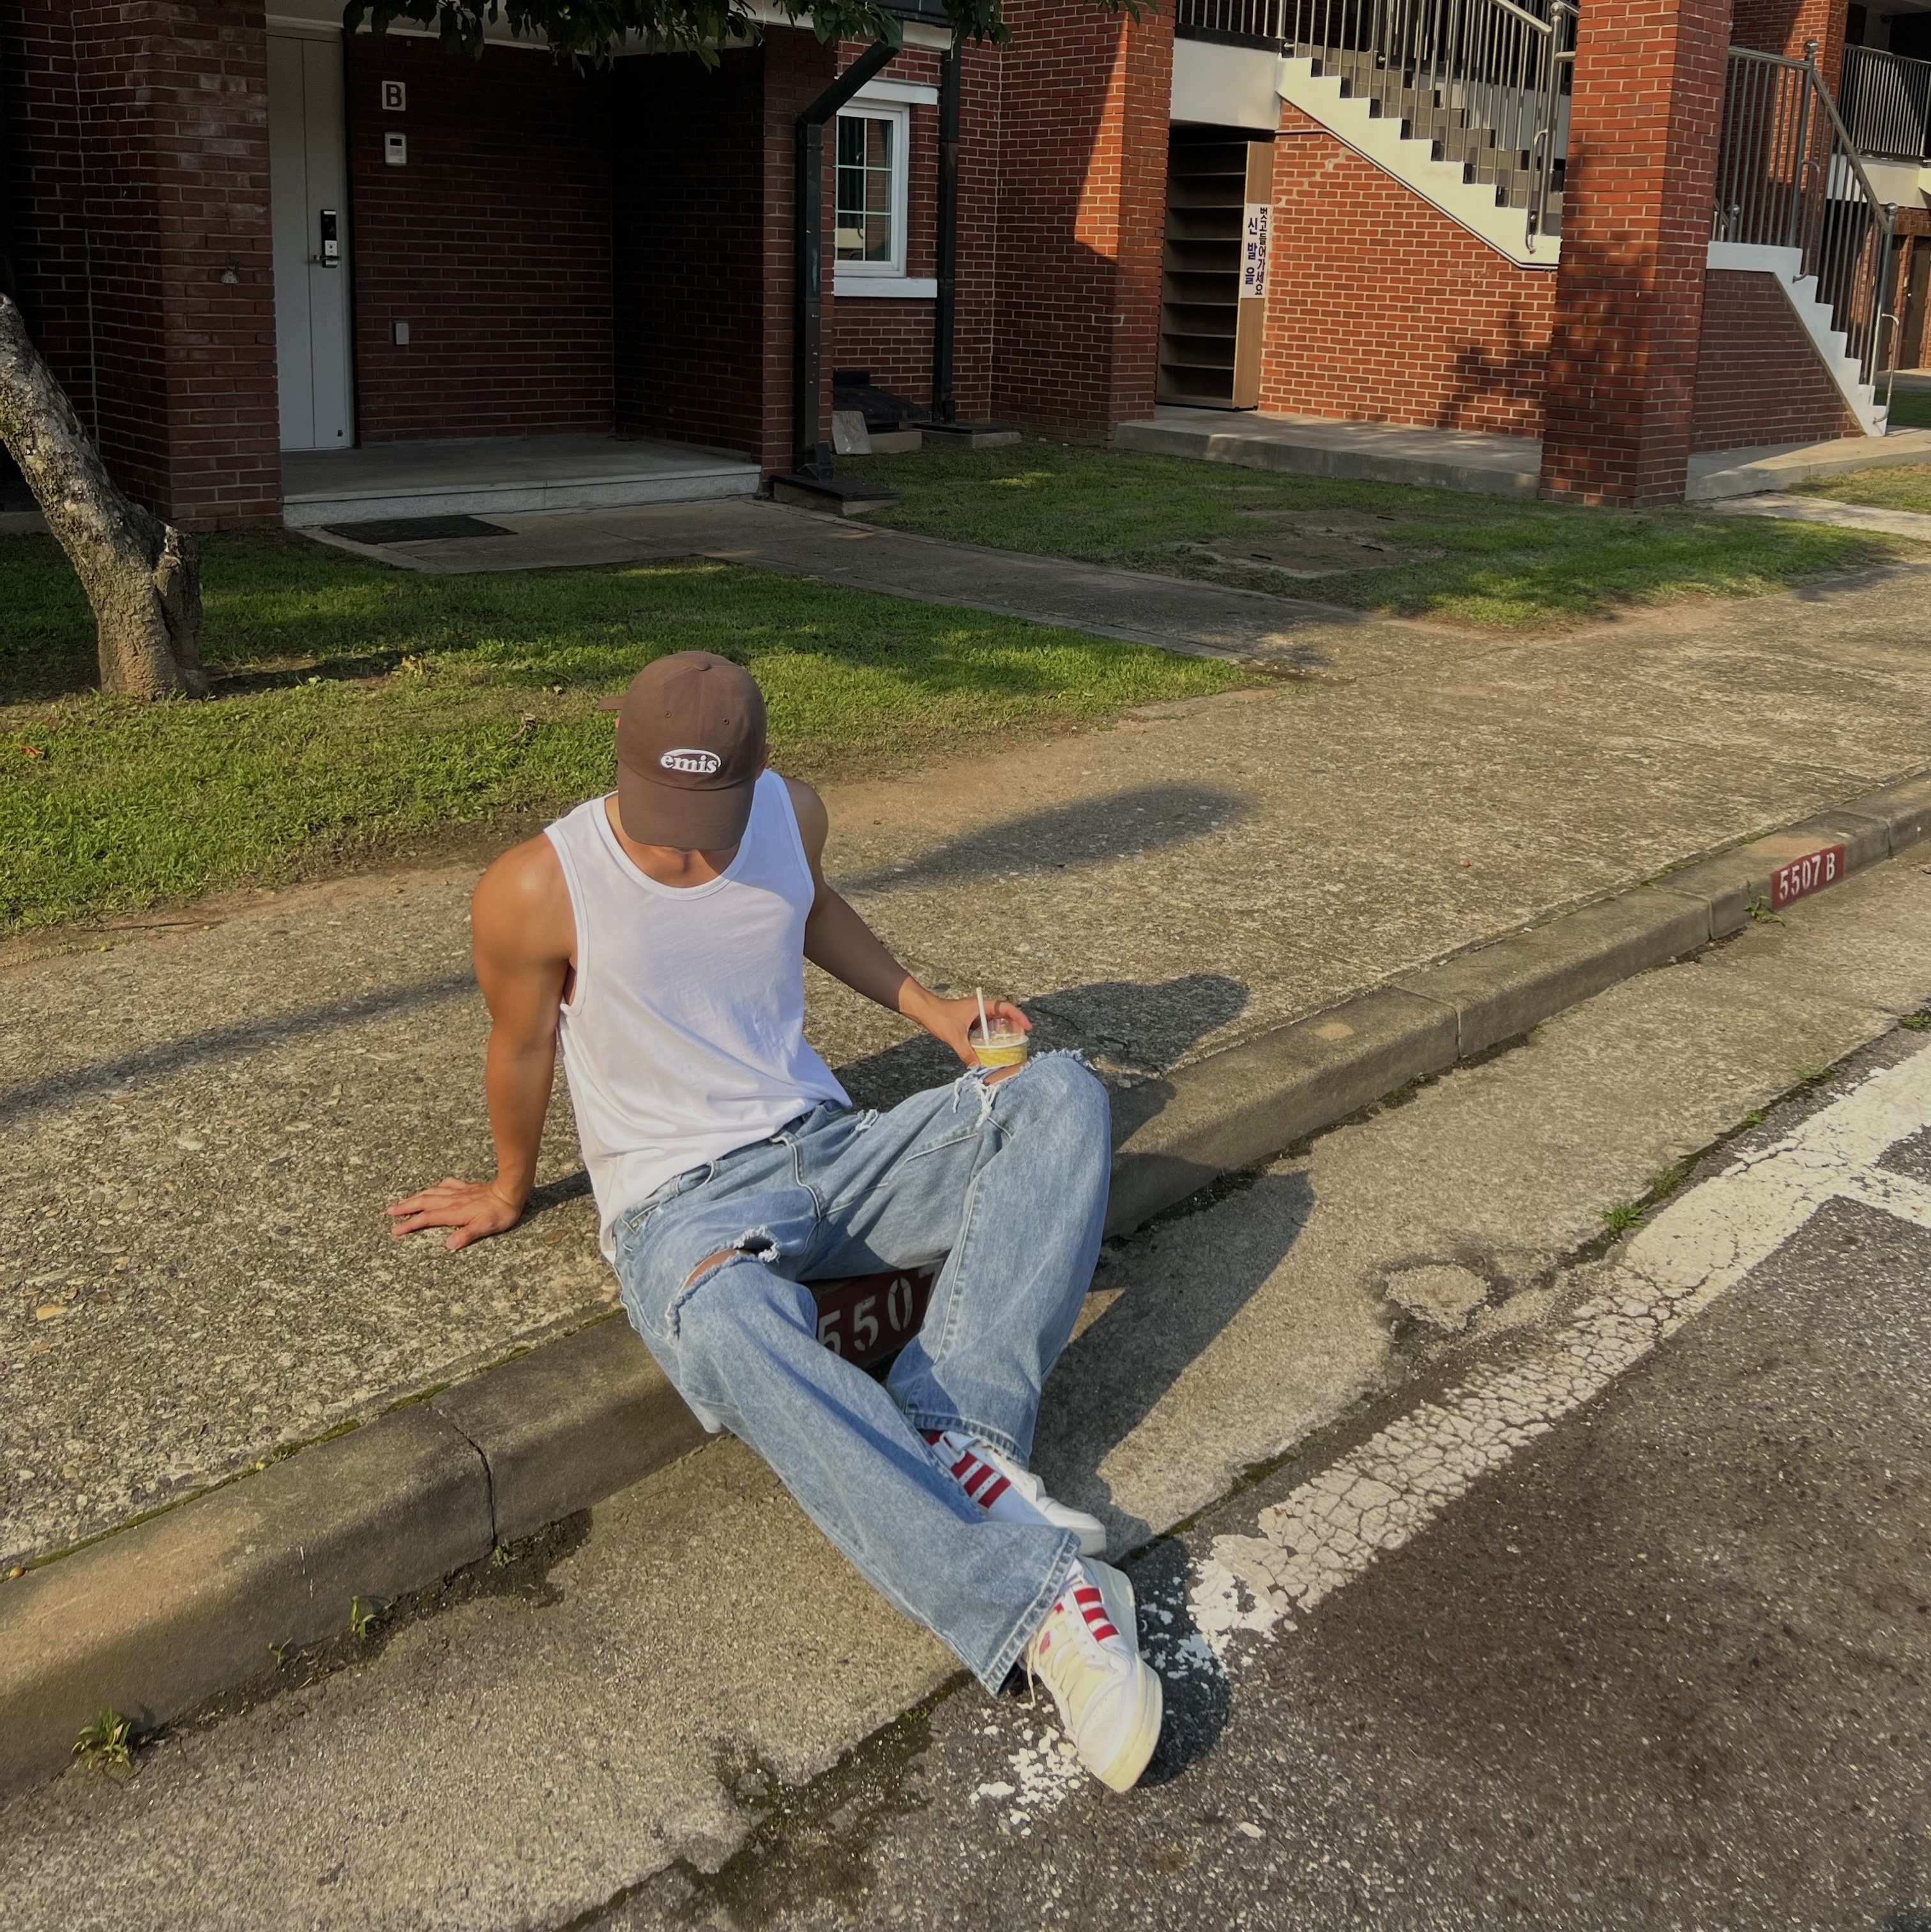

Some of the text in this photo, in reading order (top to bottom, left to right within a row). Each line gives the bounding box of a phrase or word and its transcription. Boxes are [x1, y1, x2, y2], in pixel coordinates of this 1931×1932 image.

[386, 84, 402, 107] B
[660, 754, 717, 773] emis
[1779, 853, 1835, 901] 5507 B
